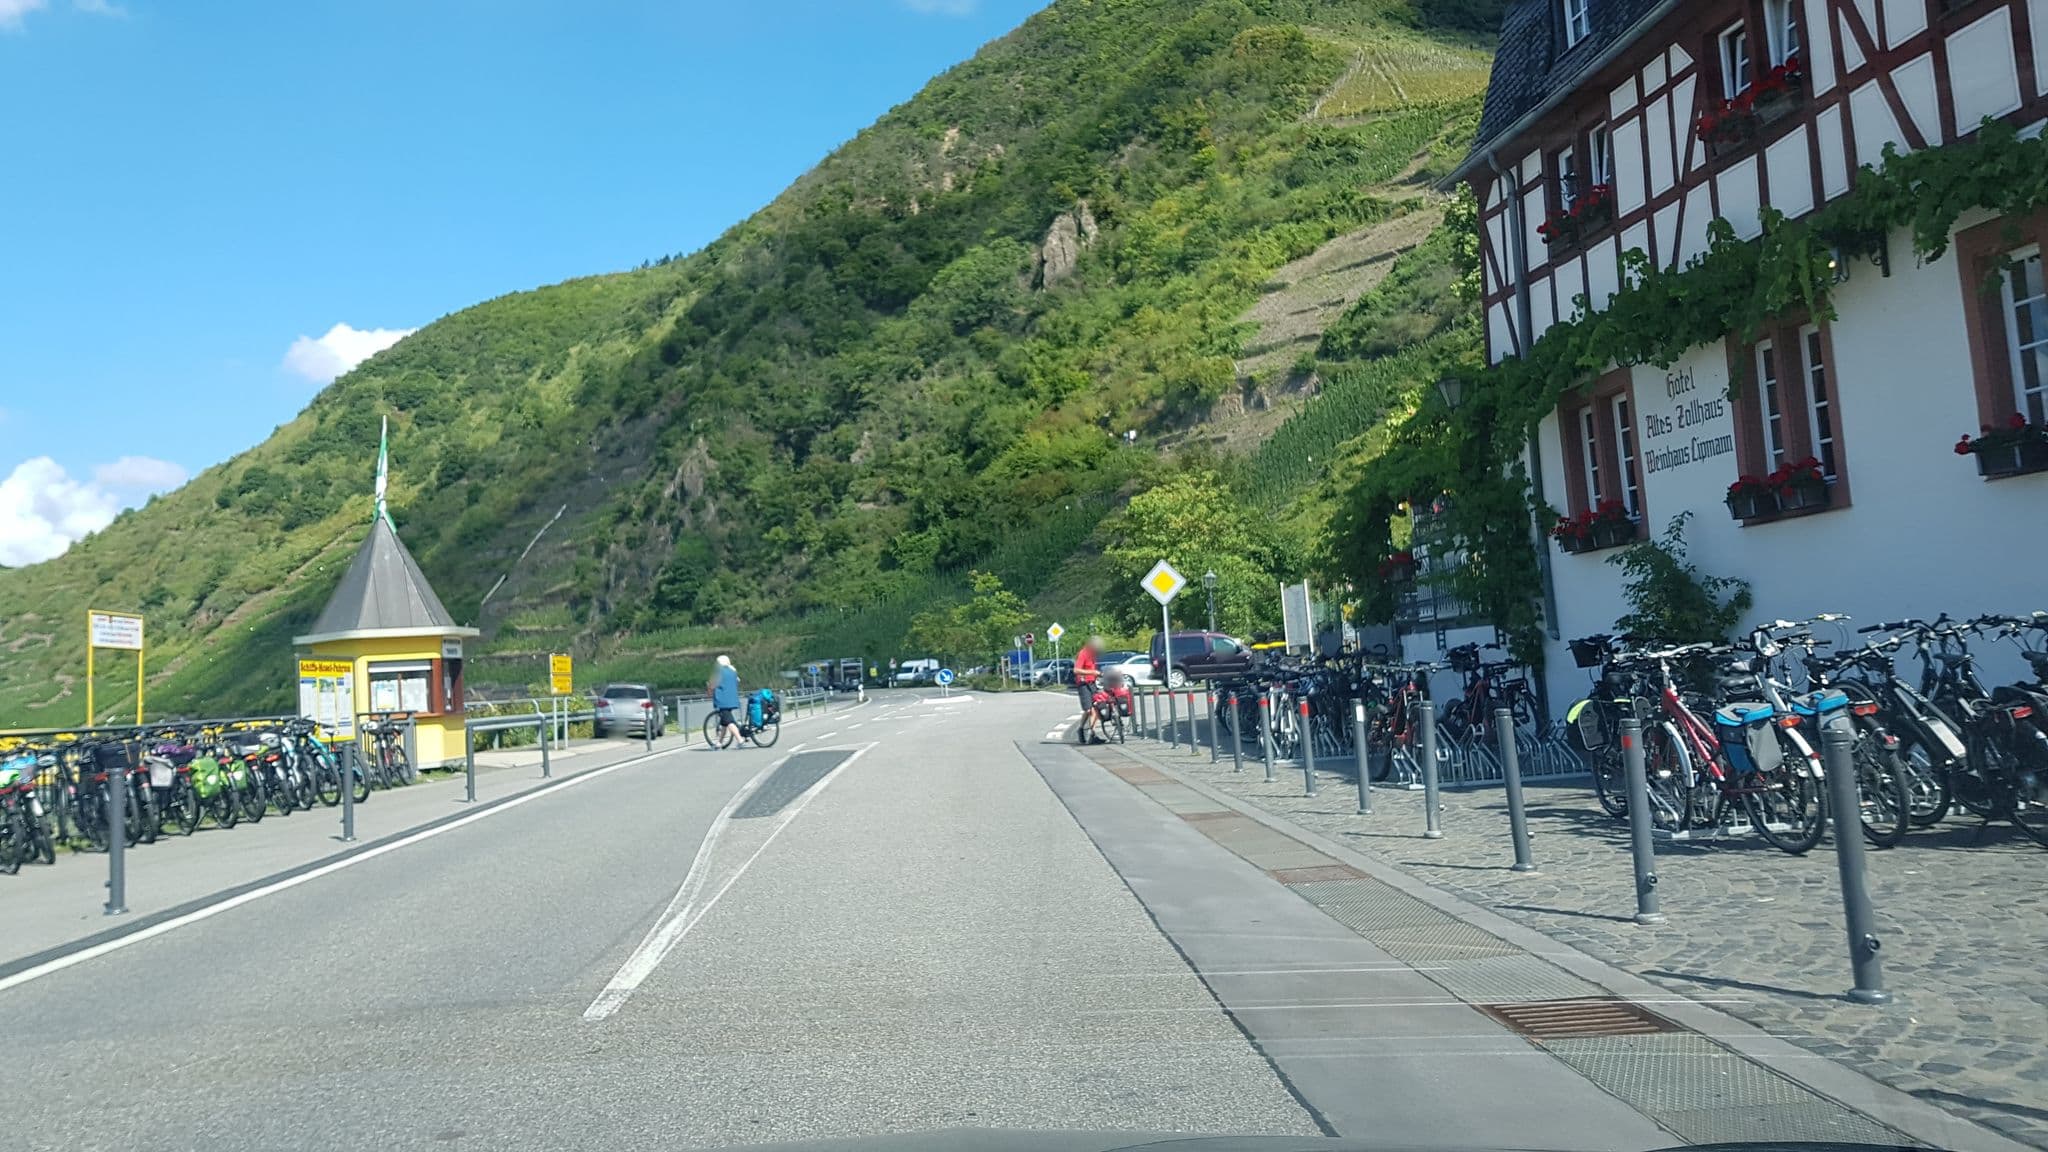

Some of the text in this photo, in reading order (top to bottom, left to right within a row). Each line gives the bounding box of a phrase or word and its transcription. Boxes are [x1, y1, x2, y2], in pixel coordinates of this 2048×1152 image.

[1666, 366, 1696, 402] Hotel
[1645, 398, 1724, 439] Altes Zollhaus
[1645, 434, 1734, 474] Weinhaus Lipmann
